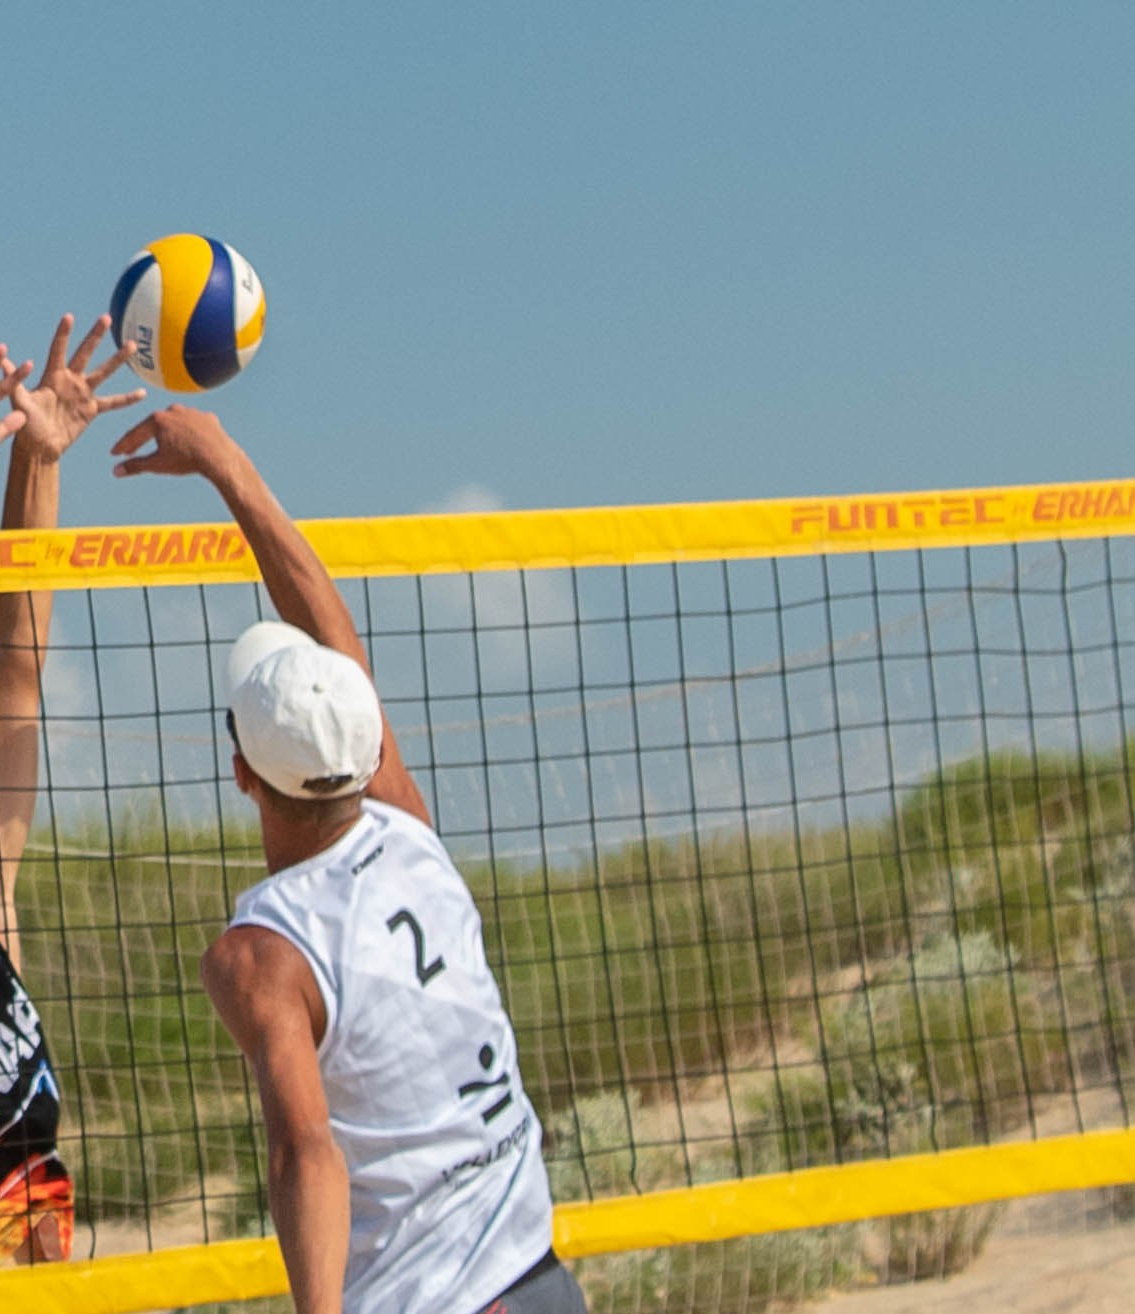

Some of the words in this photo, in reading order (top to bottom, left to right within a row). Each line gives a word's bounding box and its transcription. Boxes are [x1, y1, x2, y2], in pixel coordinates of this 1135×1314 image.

[791, 495, 1006, 535] FUNTEC
[1032, 485, 1135, 521] ERHA
[68, 527, 247, 567] ERHARD
[386, 908, 445, 987] 2
